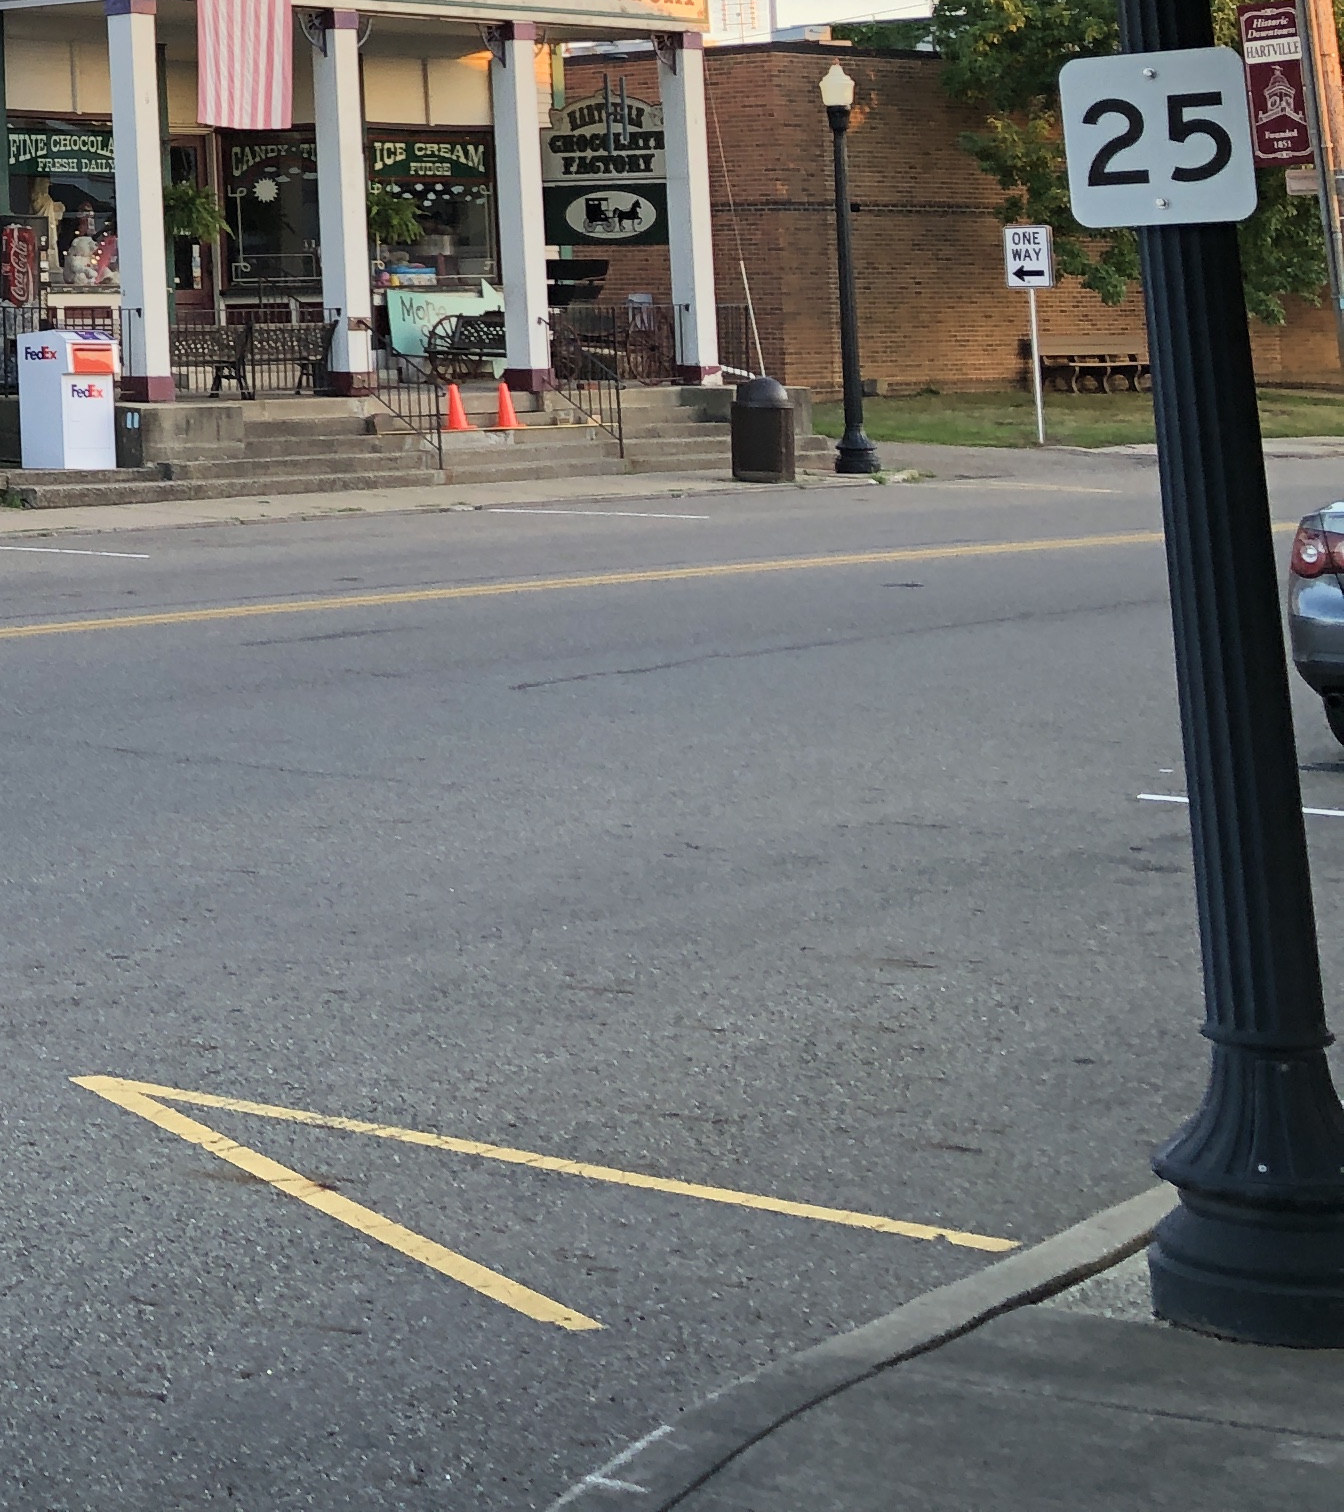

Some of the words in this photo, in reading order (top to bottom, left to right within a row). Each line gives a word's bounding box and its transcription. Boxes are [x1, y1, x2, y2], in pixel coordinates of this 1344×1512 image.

[1253, 16, 1289, 28] Historic
[1247, 27, 1296, 39] Downtown
[1246, 41, 1301, 59] HARTVILLE
[1082, 91, 1232, 187] 25
[1265, 129, 1298, 140] Founded
[8, 133, 47, 164] FINE
[51, 135, 115, 158] CHOCOLA
[1273, 141, 1292, 150] 1851
[232, 144, 288, 176] CANDY
[373, 142, 407, 171] ICE
[414, 143, 485, 173] CREAM
[562, 153, 656, 175] FACTORY
[37, 158, 78, 172] FRESH
[410, 162, 452, 176] FUDGE
[1012, 231, 1041, 245] ONE
[1012, 248, 1041, 262] WAY
[400, 296, 447, 324] More
[24, 346, 57, 361] FedEx
[71, 384, 104, 398] FedEx
